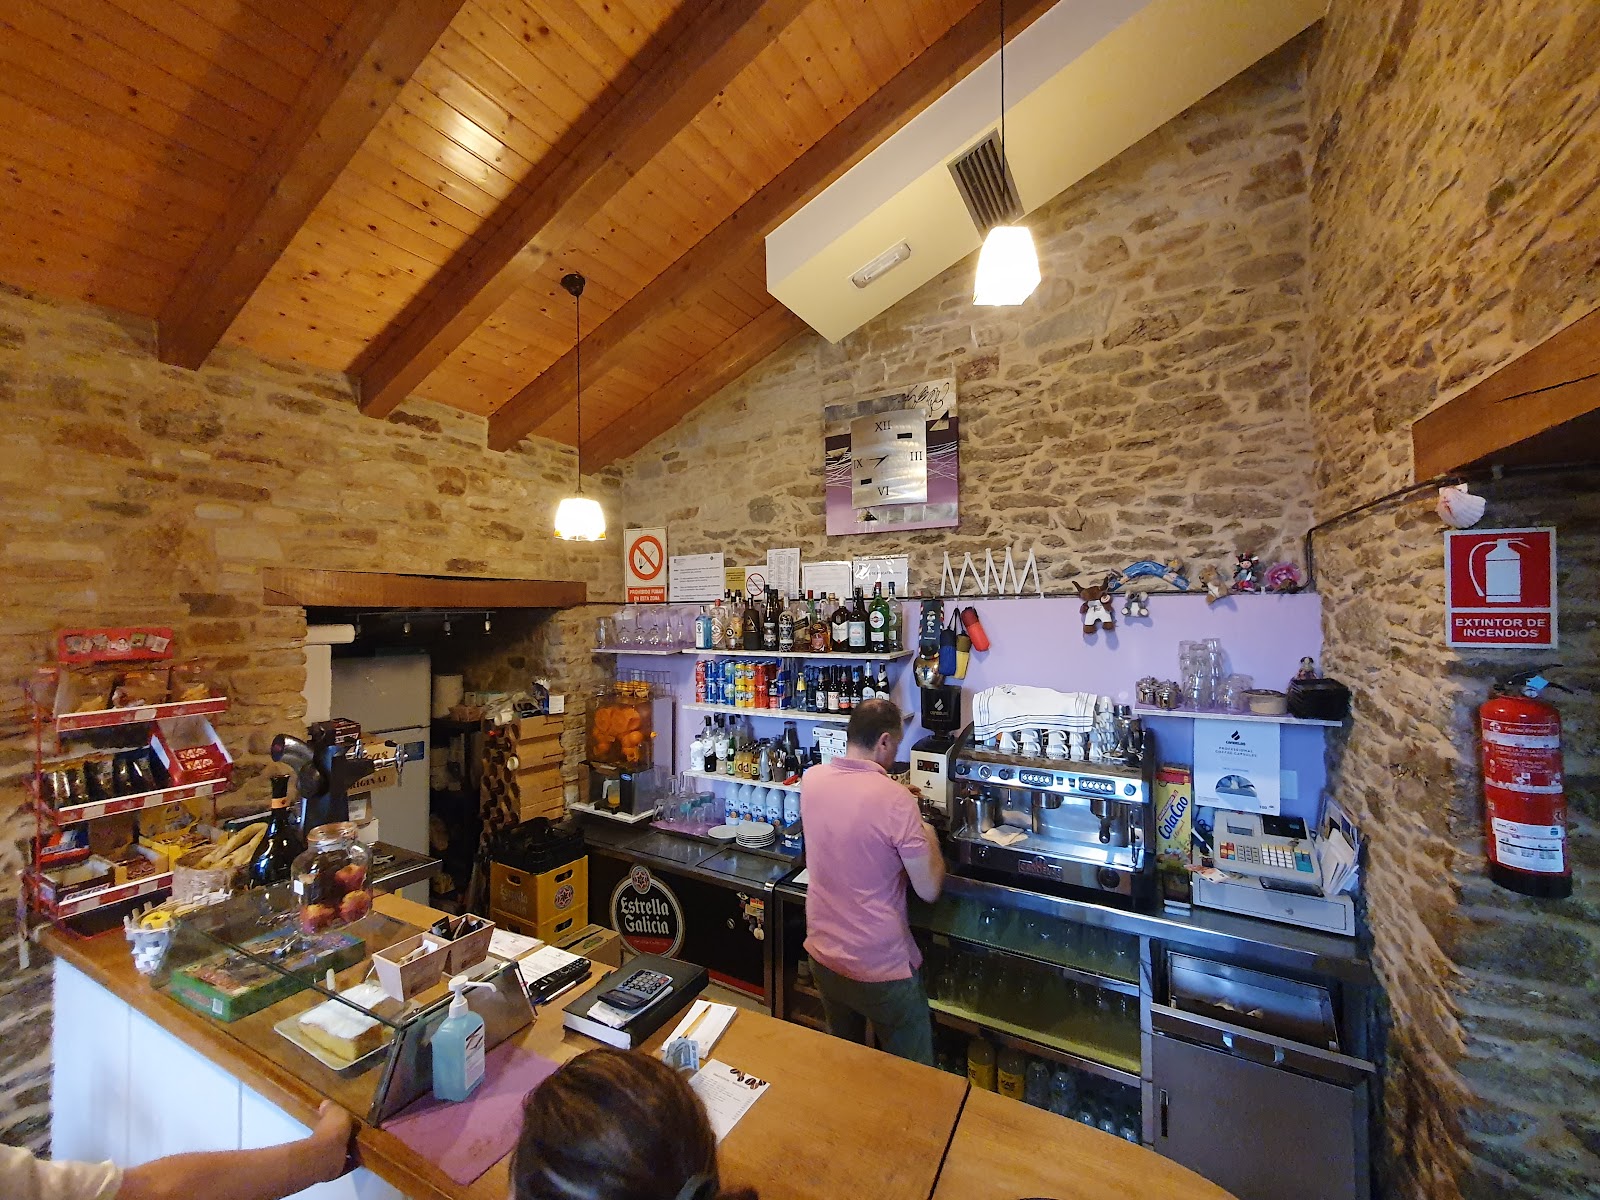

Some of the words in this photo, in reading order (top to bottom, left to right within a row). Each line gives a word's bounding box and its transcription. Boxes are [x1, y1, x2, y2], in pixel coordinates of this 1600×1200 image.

[874, 420, 891, 432] XII
[853, 459, 864, 469] IX
[910, 451, 923, 461] III
[877, 486, 889, 496] VI
[1455, 618, 1523, 627] EXTINTOR
[1526, 618, 1546, 627] DE
[1463, 628, 1539, 637] INCENDIOS
[1158, 796, 1188, 840] ColaCao
[620, 896, 669, 916] Estrella
[624, 914, 670, 935] Galicia
